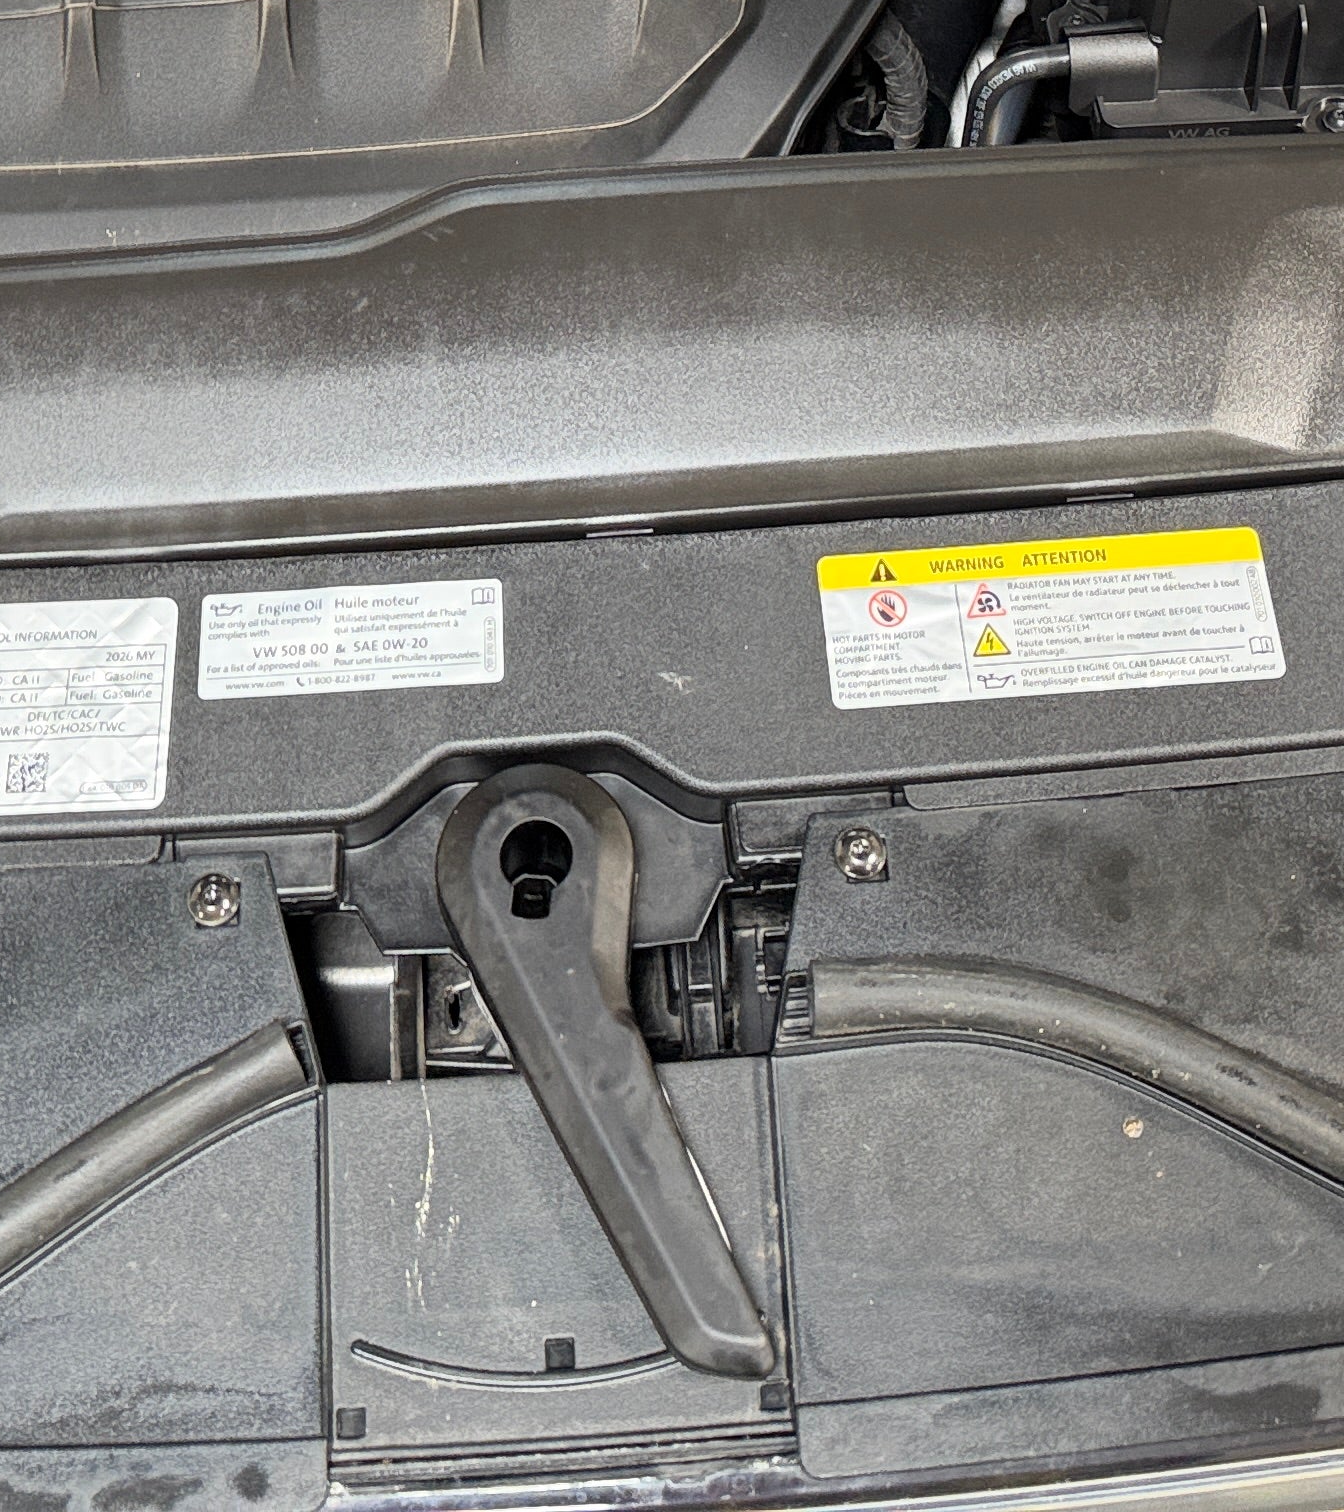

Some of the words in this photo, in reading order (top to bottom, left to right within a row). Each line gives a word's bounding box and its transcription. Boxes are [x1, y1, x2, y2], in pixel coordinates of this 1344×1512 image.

[1206, 126, 1230, 138] AG
[929, 555, 1005, 574] WARNING
[1022, 548, 1107, 568] ATTENTION
[1007, 580, 1051, 590] RADIATOR
[1053, 579, 1071, 588] FAN
[1072, 577, 1091, 586] MAY
[1093, 575, 1119, 585] START
[1121, 574, 1132, 583] AT
[1133, 572, 1151, 581] ANY
[1009, 594, 1020, 602] Le
[1021, 591, 1070, 601] ventilateur
[1072, 589, 1084, 598] de
[1085, 587, 1126, 597] radiateur
[1128, 585, 1149, 595] peut
[1150, 585, 1161, 593] se
[1162, 579, 1211, 592] déclencher
[1213, 579, 1219, 588] à
[1221, 578, 1241, 588] tout
[257, 602, 301, 617] Engine
[304, 599, 323, 612] Oil
[334, 597, 369, 609] Huile
[371, 595, 420, 608] moteur
[334, 614, 368, 624] Utilisez
[369, 610, 425, 624] uniquement
[426, 609, 438, 618] de
[439, 607, 468, 617] l'huile
[1079, 612, 1113, 622] SWITCH
[1114, 611, 1132, 620] OFF
[1133, 608, 1167, 619] ENGINE
[1168, 605, 1204, 616] BEFORE
[1205, 602, 1251, 614] TOUCHING
[208, 621, 226, 630] Use
[227, 619, 247, 631] only
[248, 618, 259, 628] oil
[260, 617, 280, 627] that
[280, 615, 323, 627] expressly
[334, 626, 349, 636] qui
[350, 623, 387, 634] satisfait
[388, 619, 451, 632] expressément
[452, 619, 460, 628] à
[1013, 618, 1035, 627] HIGH
[14, 628, 98, 643] INFORMATION
[207, 630, 248, 642] complies
[249, 629, 271, 638] with
[832, 636, 851, 645] HOT
[853, 634, 880, 643] PARTS
[881, 633, 892, 641] IN
[893, 630, 926, 640] MOTOR
[1014, 627, 1055, 636] IGNITION
[1016, 638, 1044, 648] Haute
[1116, 632, 1125, 641] le
[1126, 630, 1160, 639] moteur
[1161, 629, 1188, 638] avant
[1189, 627, 1201, 636] de
[1202, 625, 1237, 635] toucher
[1239, 624, 1245, 633] à
[252, 646, 278, 659] VW
[281, 644, 306, 657] 508
[310, 642, 329, 655] 00
[336, 643, 346, 654] &
[353, 639, 379, 653] SAE
[382, 636, 429, 651] 0W-20
[136, 650, 156, 661] MY
[333, 656, 354, 667] Pour
[355, 656, 373, 665] une
[374, 654, 392, 664] liste
[394, 652, 428, 663] d'huiles
[834, 654, 872, 665] MOVING
[206, 665, 222, 674] For
[222, 665, 229, 673] a
[230, 663, 245, 672] list
[246, 662, 256, 672] of
[257, 660, 301, 672] approved
[836, 666, 890, 679] Composants
[909, 663, 941, 674] chauds
[942, 662, 963, 671] dans
[1020, 665, 1075, 677] OVERFILLED
[1077, 662, 1111, 673] ENGINE
[1112, 661, 1126, 670] OIL
[1128, 660, 1148, 669] CAN
[1149, 656, 1187, 667] DAMAGE
[12, 674, 30, 686] CA
[104, 671, 154, 683] Gasoline
[391, 670, 442, 680] www.vw.ca
[837, 681, 846, 689] le
[847, 676, 913, 689] compartiment
[1022, 677, 1079, 689] Remplissage
[1080, 673, 1116, 683] excessif
[1117, 670, 1148, 681] d'huile
[1149, 668, 1196, 680] dangereux
[1198, 667, 1219, 677] pour
[1220, 666, 1229, 674] le
[1230, 663, 1277, 674] catalyseur
[225, 681, 285, 690] www.vw.com
[10, 693, 28, 704] CA
[102, 689, 153, 701] Gasoline
[838, 690, 868, 700] Pièces
[869, 690, 881, 698] en
[27, 708, 102, 723] DFI/TC/CAC/
